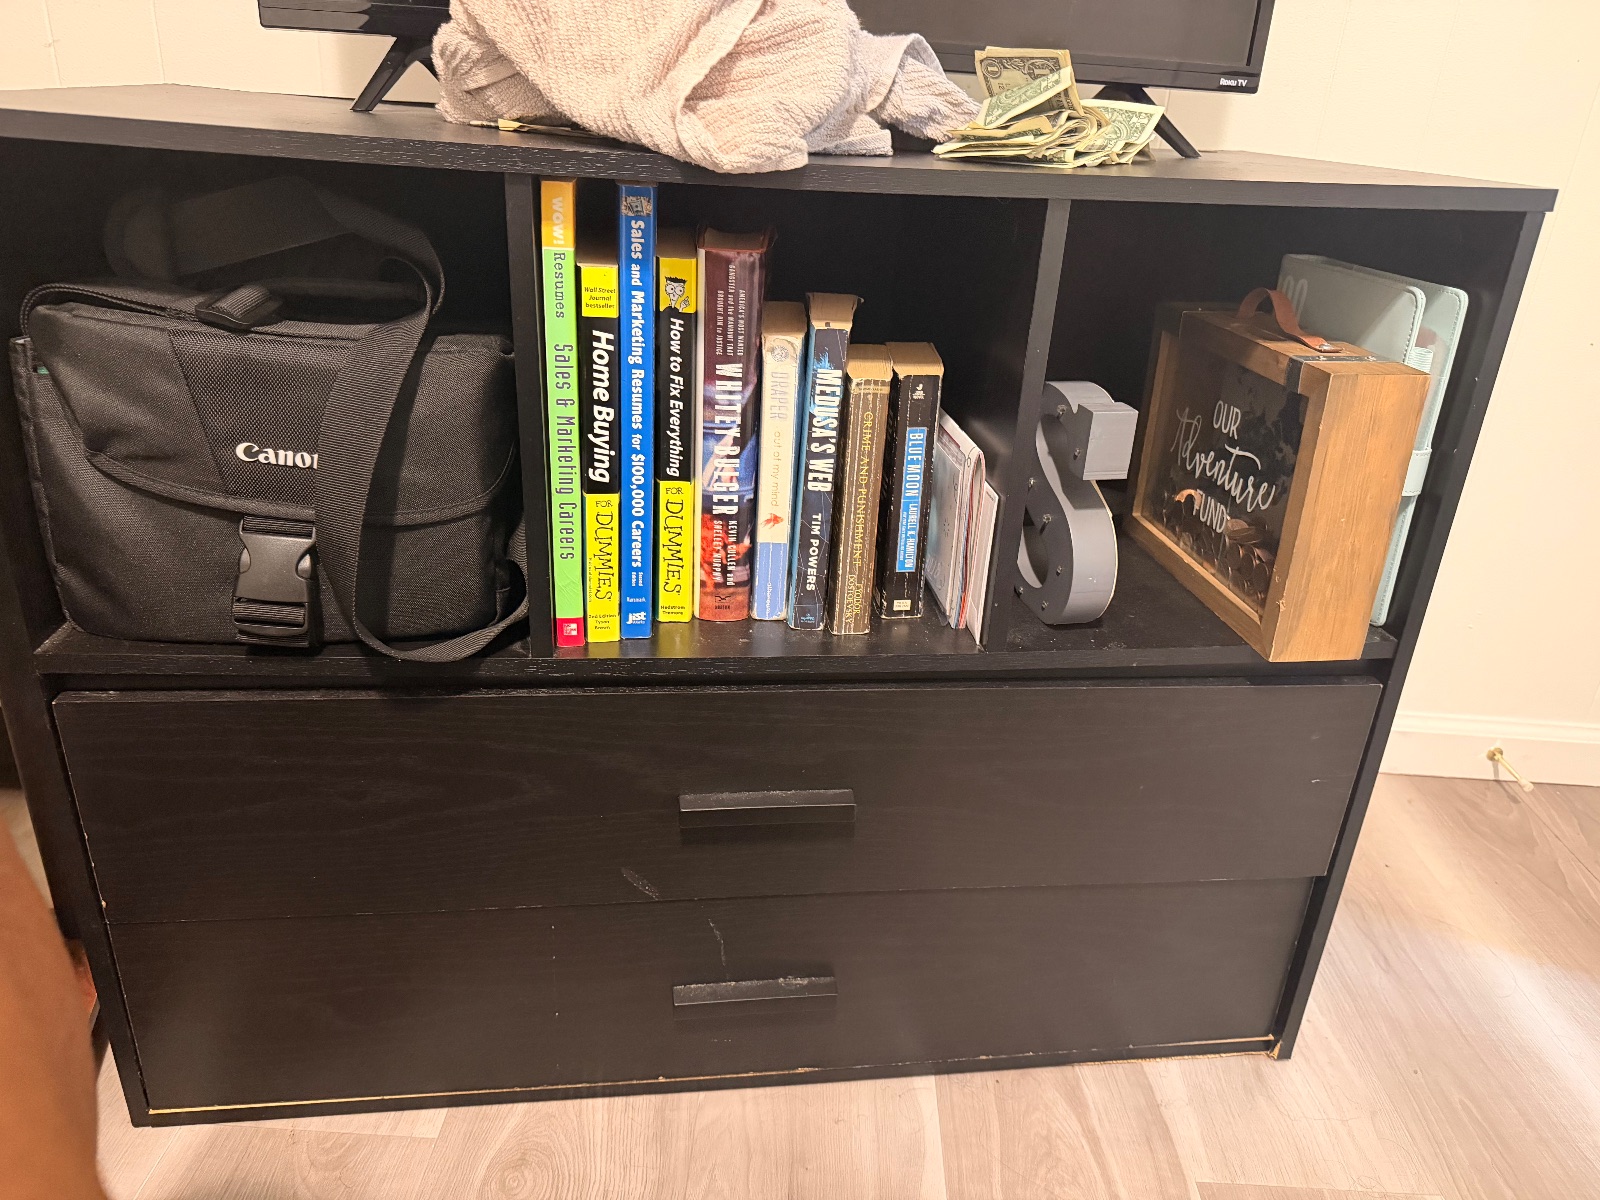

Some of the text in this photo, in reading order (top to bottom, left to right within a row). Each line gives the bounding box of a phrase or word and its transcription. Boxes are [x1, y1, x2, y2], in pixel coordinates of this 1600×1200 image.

[1220, 77, 1248, 87] Roku TV
[552, 196, 565, 245] WOW!
[553, 252, 565, 319] Resumes
[728, 264, 736, 293] GANGSTER
[737, 319, 745, 334] MOST
[738, 289, 746, 319] AMERICA'S
[553, 344, 574, 390] Sales
[715, 334, 724, 356] JUSTICE
[589, 330, 615, 483] Home Buying
[628, 220, 645, 568] Sales and Marketing Resumes for $100,000 Careers
[667, 318, 684, 477] How to Fix Everything
[770, 371, 789, 421] DRAPER
[712, 363, 743, 515] WHITEY BULGER
[774, 431, 782, 448] out
[807, 368, 842, 492] MEDUSA'S WEB
[1213, 400, 1241, 440] OUR
[556, 416, 576, 495] Marketing
[770, 464, 780, 479] my
[773, 451, 781, 462] of
[904, 433, 924, 497] BLUE MOON
[1170, 407, 1276, 513] Adventure
[595, 500, 613, 508] FOR
[665, 487, 684, 495] FOR
[770, 482, 780, 507] mind
[852, 411, 874, 567] CRIME AND PUNISHMENT
[1193, 489, 1227, 533] FUND
[558, 502, 577, 560] Careers
[908, 503, 918, 529] LAURELL
[594, 512, 614, 601] DUMMIES
[663, 499, 684, 594] DUMMIES
[712, 520, 722, 581] SHELLEY MURPHY
[726, 520, 737, 586] KEVIN CULLEN and
[806, 513, 821, 591] TIM POWERS
[904, 538, 915, 568] HAMILTON
[853, 584, 863, 614] FYODOR
